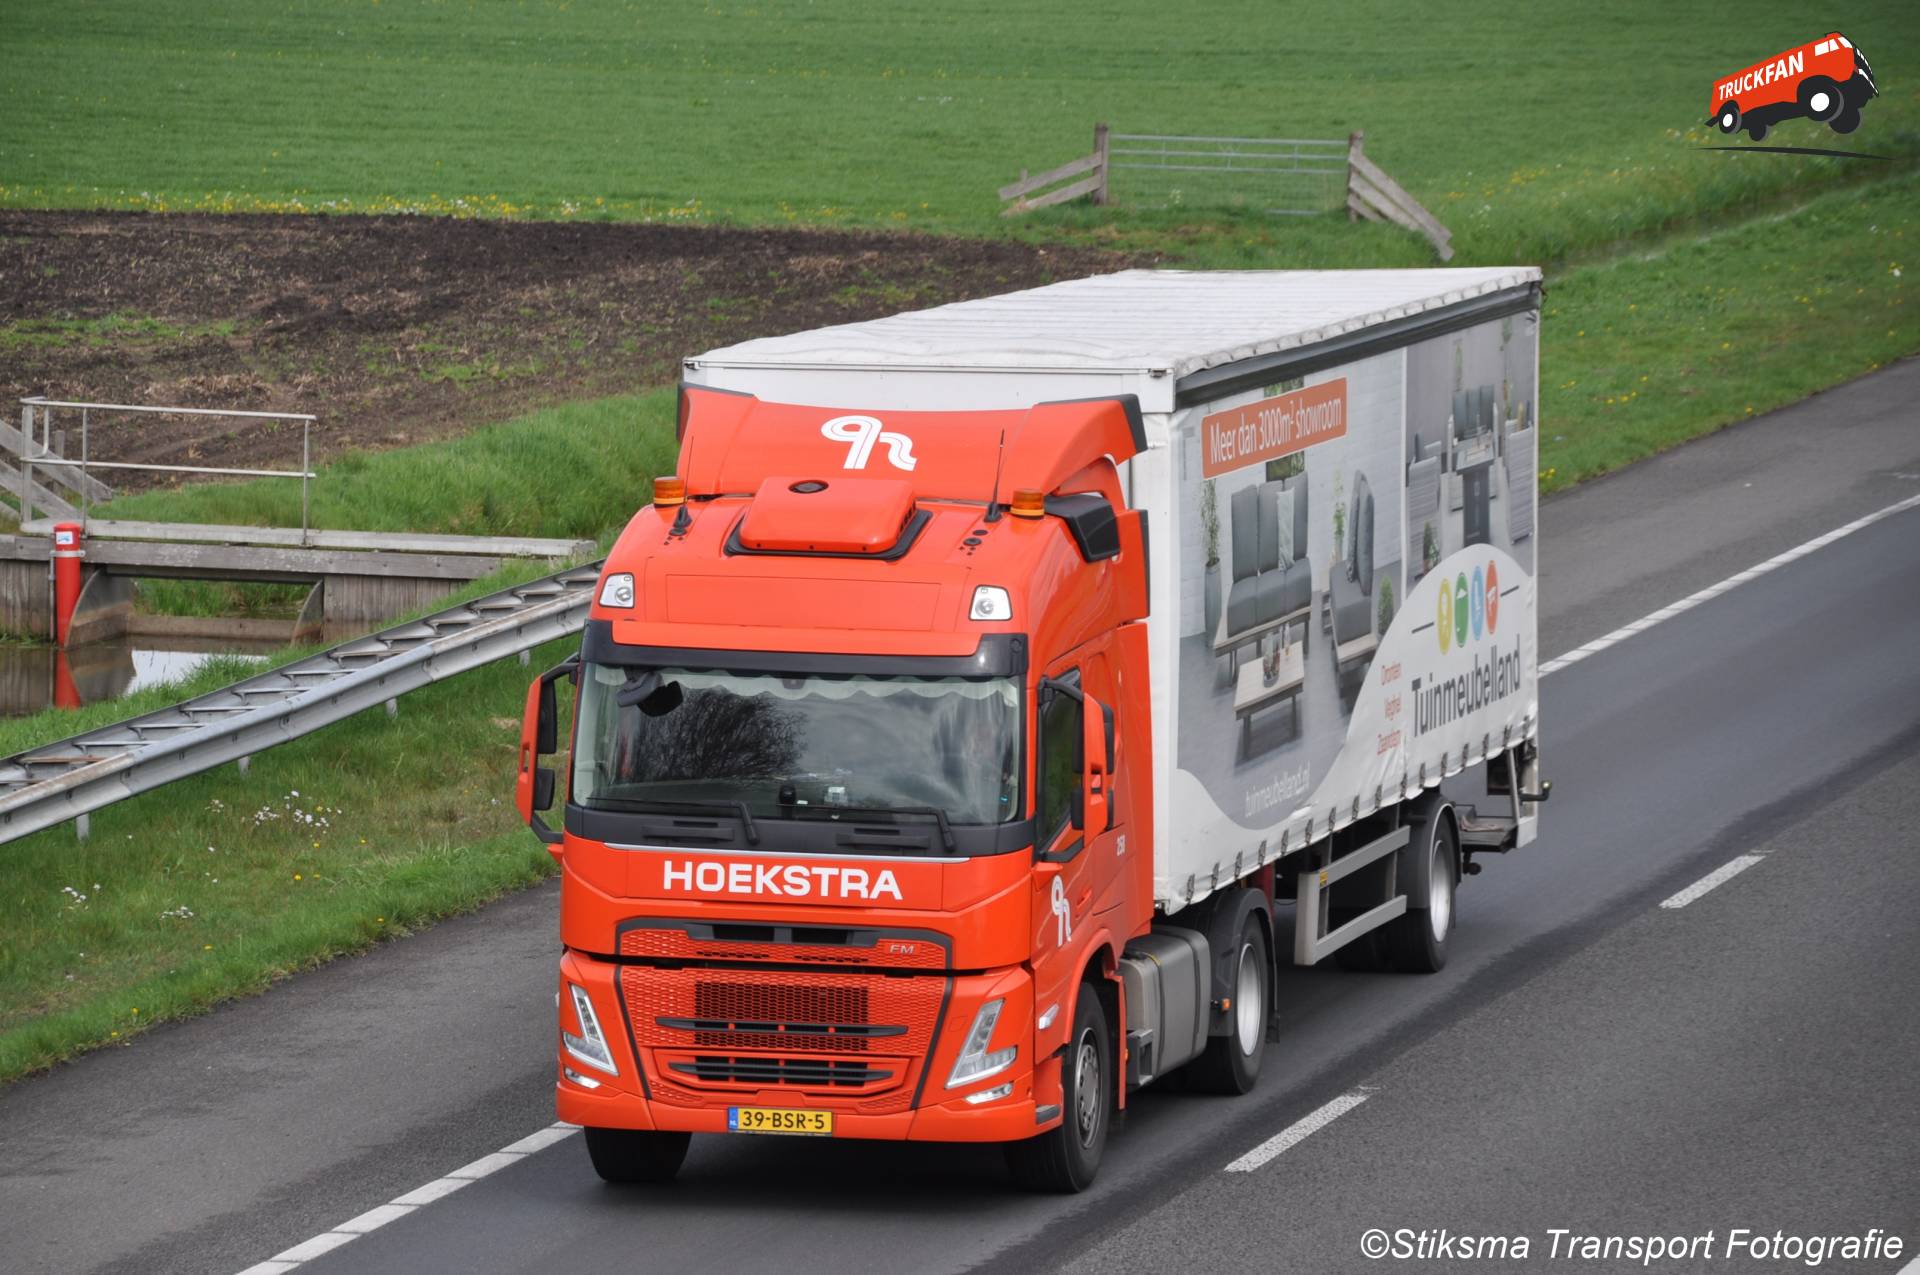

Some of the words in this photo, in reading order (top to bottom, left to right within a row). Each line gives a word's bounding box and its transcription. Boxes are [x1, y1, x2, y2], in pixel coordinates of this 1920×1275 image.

[1210, 423, 1236, 464] Meer
[1238, 413, 1257, 456] dan
[1296, 398, 1341, 439] showroom
[1411, 634, 1521, 738] Tuinmeubelland
[663, 860, 903, 900] HOEKSTRA
[889, 944, 914, 955] FM
[743, 1111, 825, 1130] 39-BSR-5
